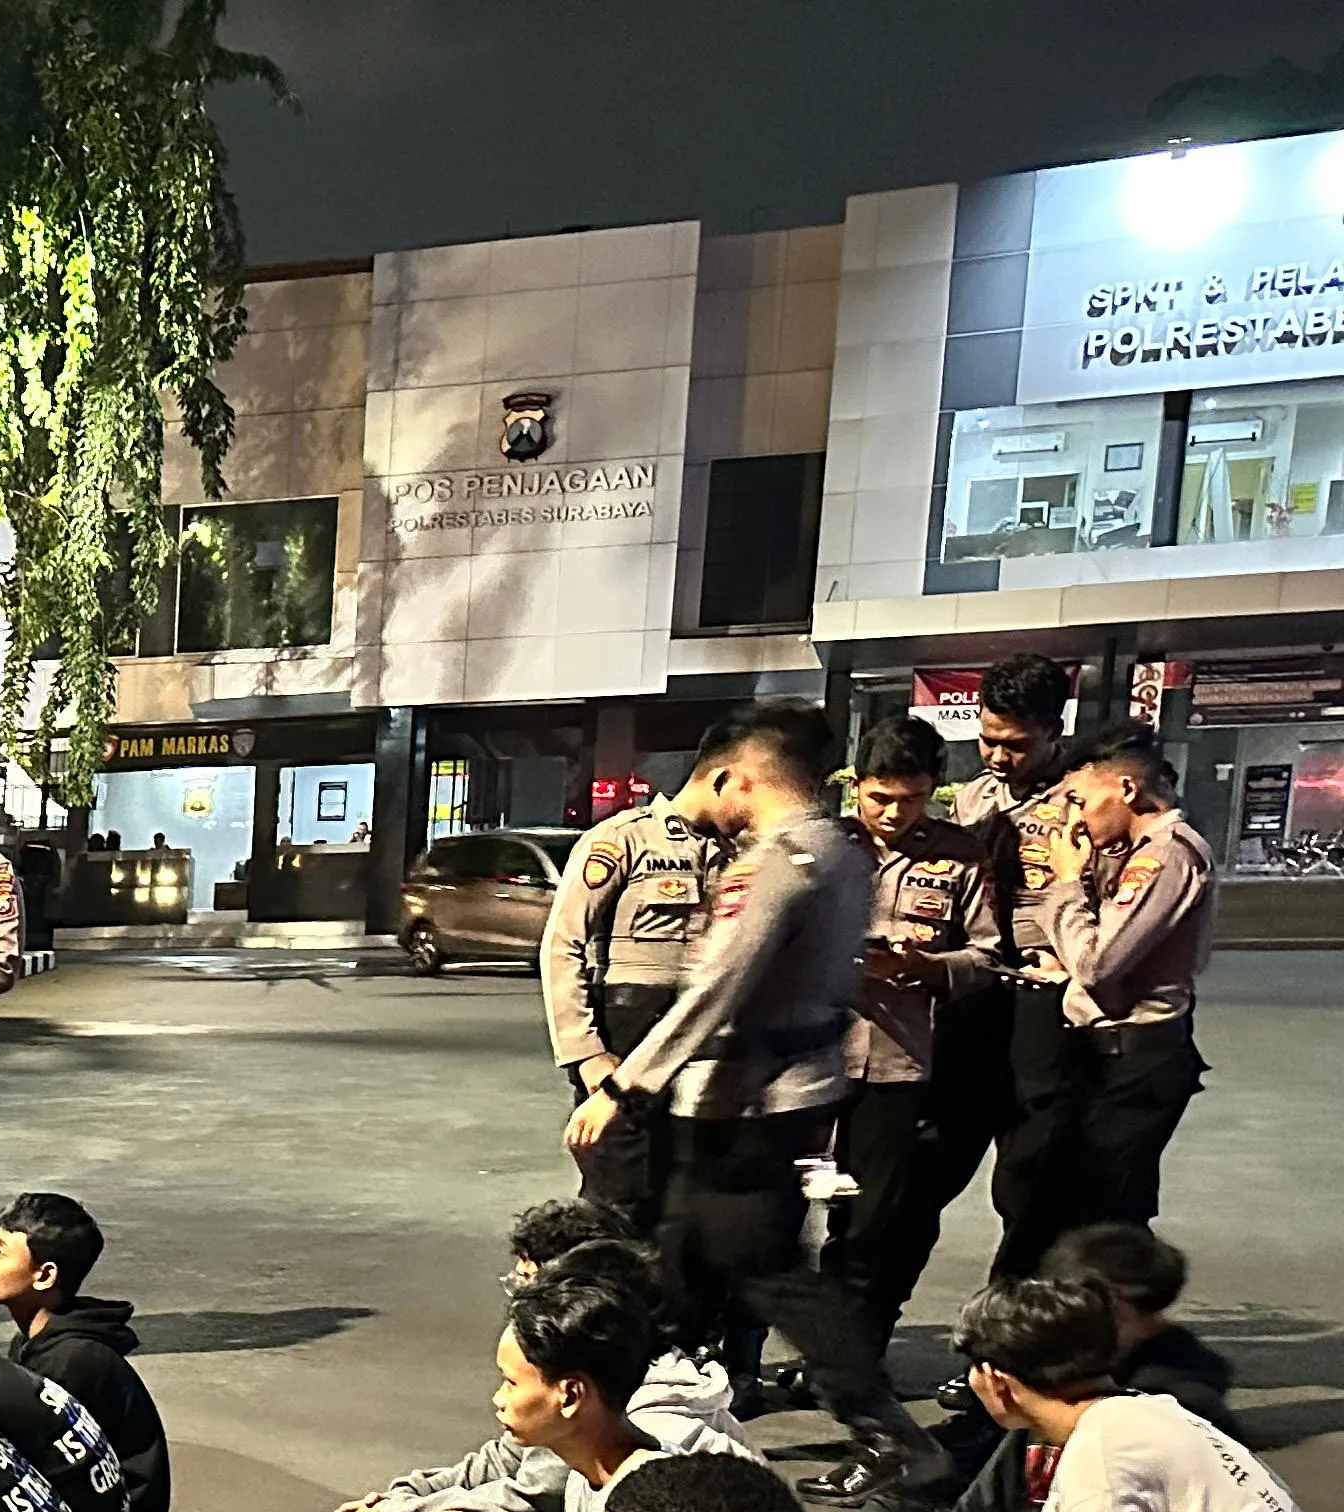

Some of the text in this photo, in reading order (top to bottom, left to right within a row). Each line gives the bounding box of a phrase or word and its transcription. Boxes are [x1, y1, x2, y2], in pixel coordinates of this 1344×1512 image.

[1091, 277, 1184, 309] SPKT
[1203, 271, 1226, 297] &
[392, 463, 657, 505] POS PENJAGAAN
[387, 500, 654, 535] POLRESTABES SURABAYA
[119, 734, 230, 758] PAM MARKAS
